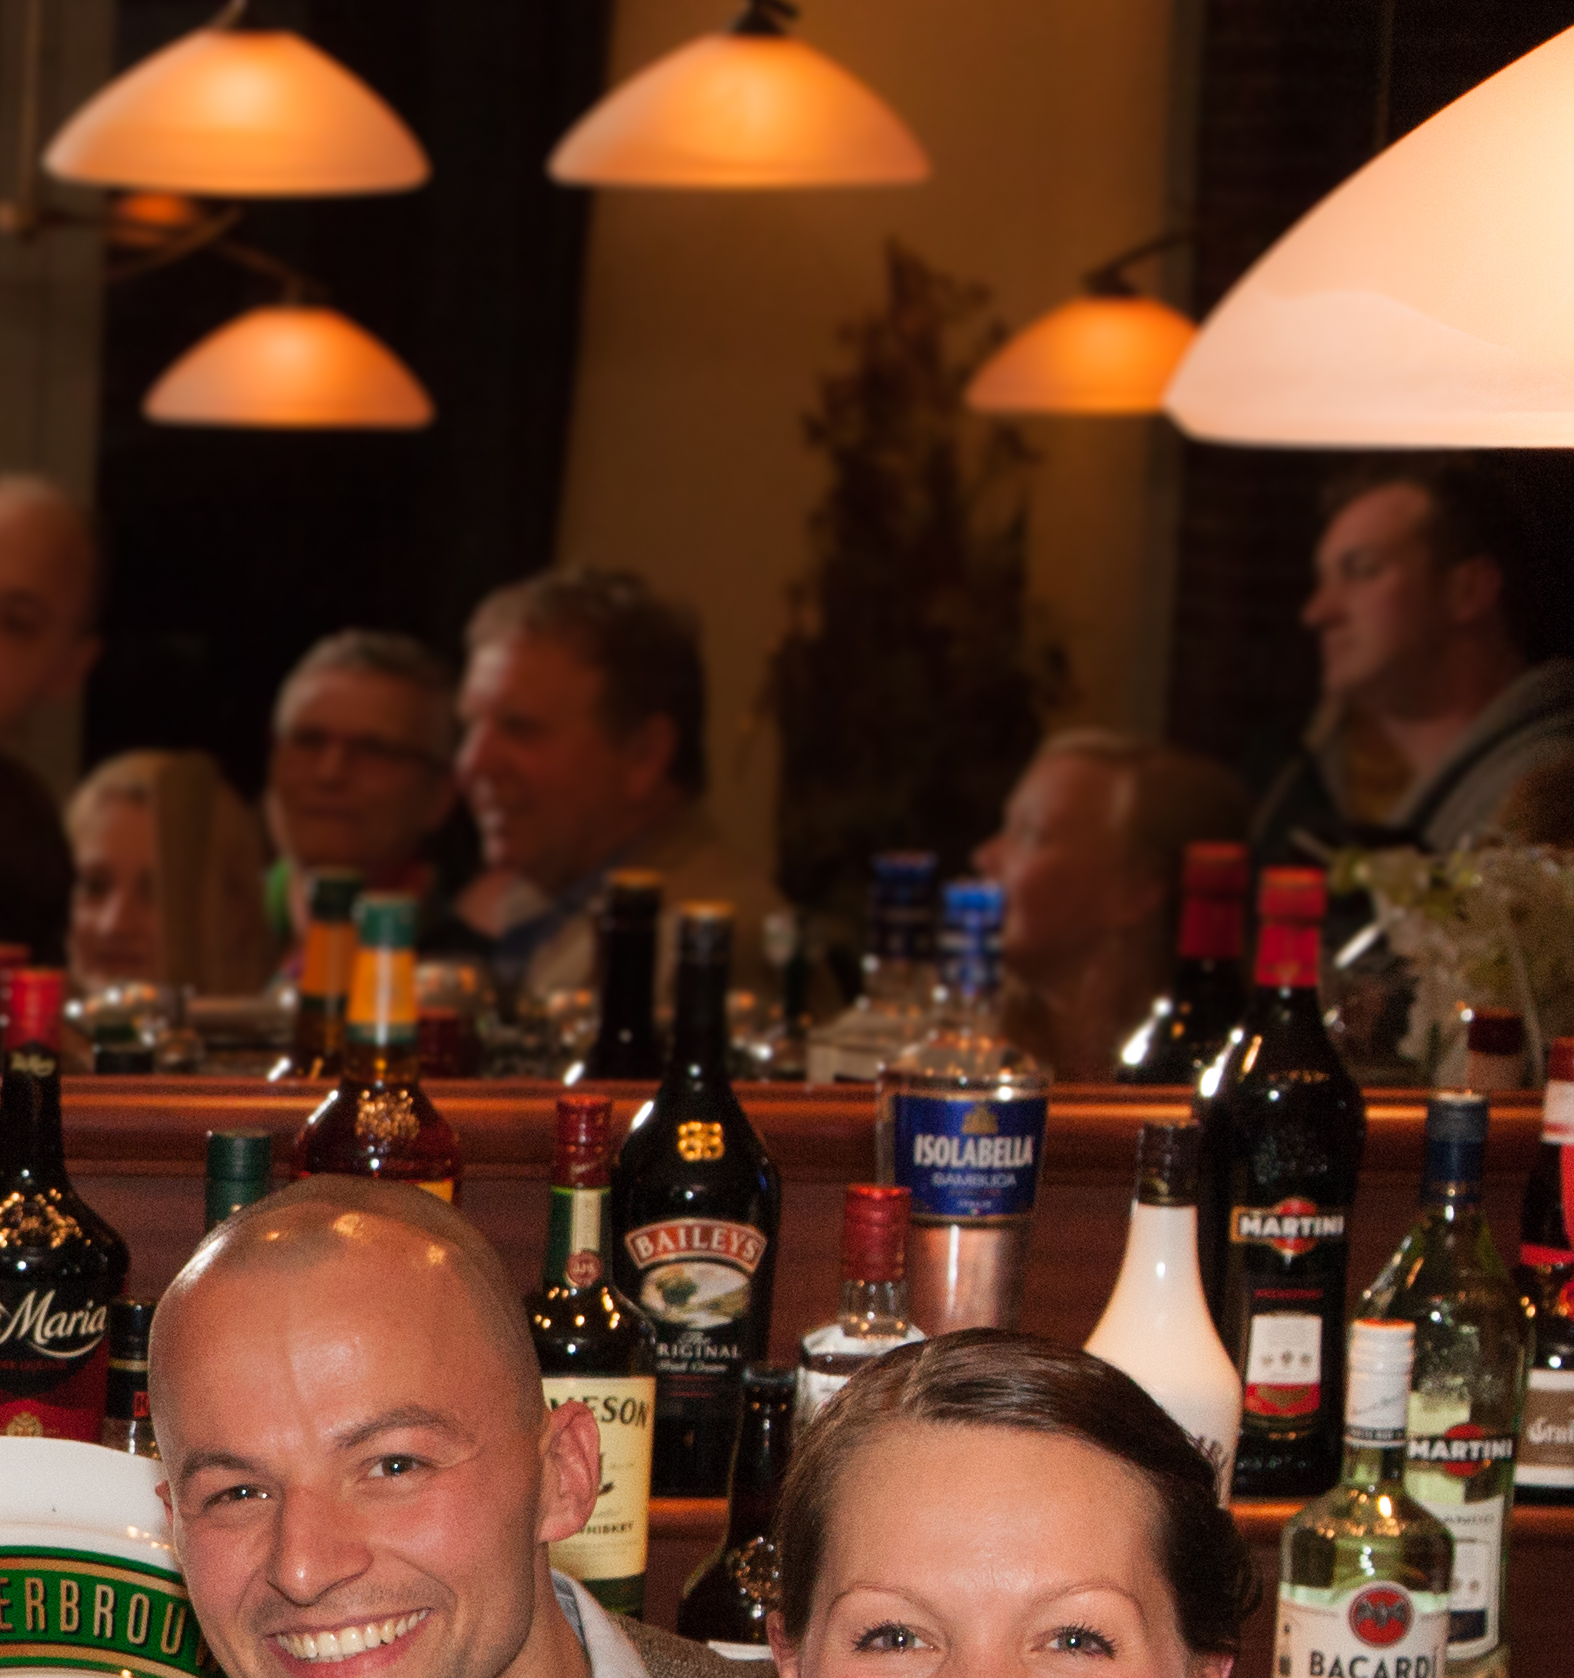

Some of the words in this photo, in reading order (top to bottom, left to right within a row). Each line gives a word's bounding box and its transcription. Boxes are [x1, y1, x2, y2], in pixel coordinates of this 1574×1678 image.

[1239, 1215, 1344, 1237] MARTINI
[634, 1226, 755, 1259] BAILEYS
[1406, 1438, 1514, 1460] MARTINI
